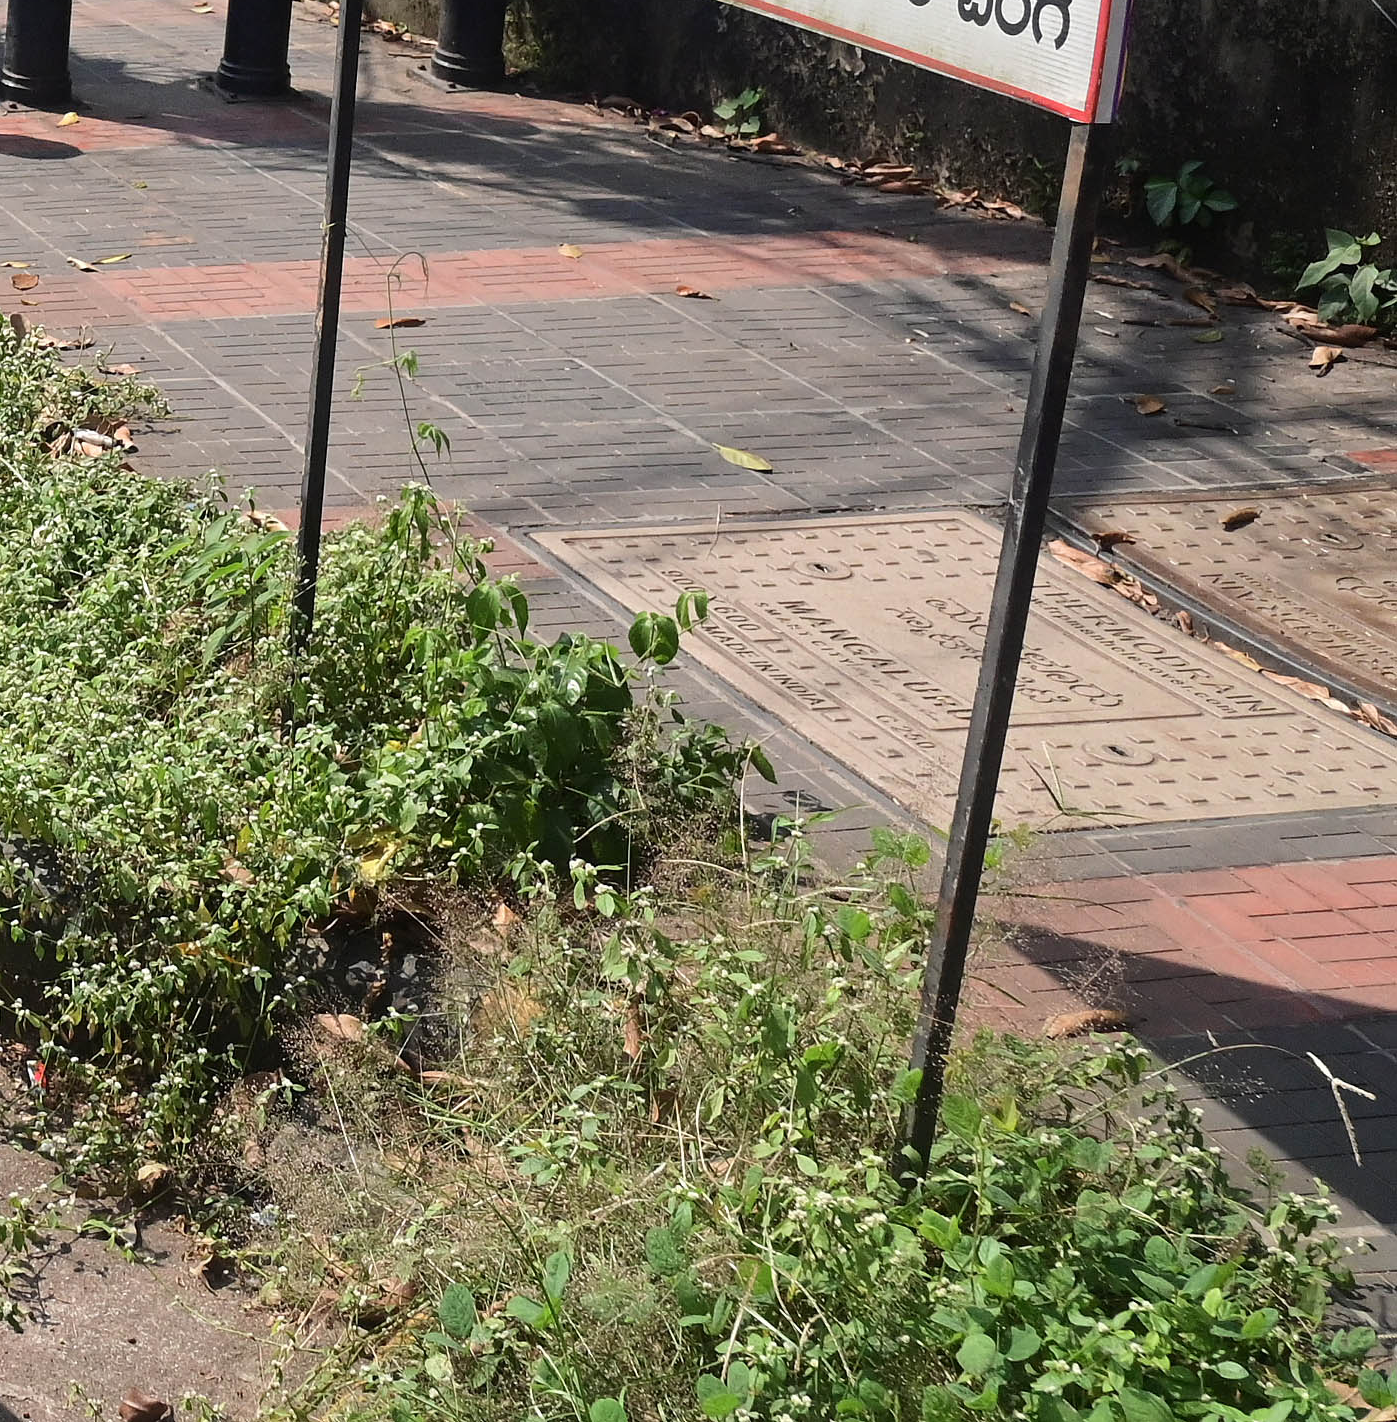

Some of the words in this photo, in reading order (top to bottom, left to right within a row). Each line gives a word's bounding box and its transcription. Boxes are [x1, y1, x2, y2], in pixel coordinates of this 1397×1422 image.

[708, 605, 765, 631] 600
[806, 639, 857, 665] CITY
[1033, 581, 1277, 712] THERMODRAIN
[695, 624, 761, 658] MADE
[766, 673, 828, 706] INDIA
[777, 599, 973, 720] MANGALURU
